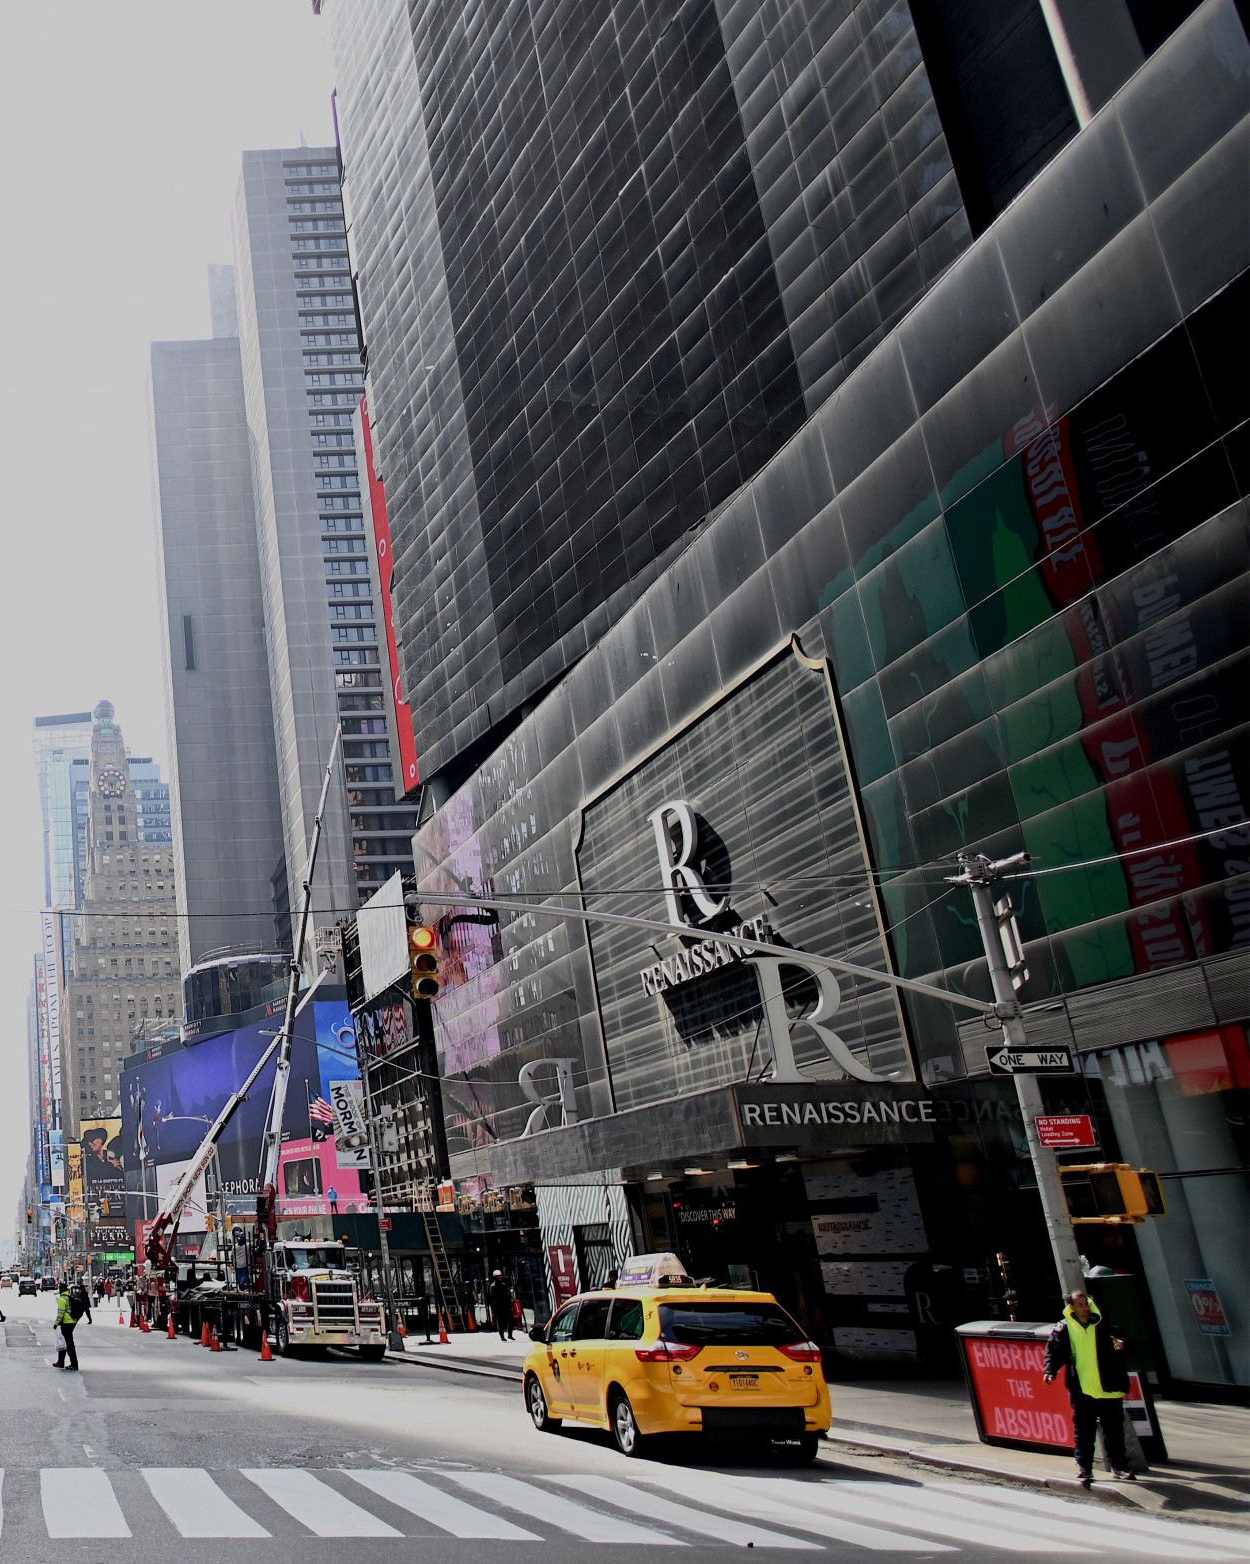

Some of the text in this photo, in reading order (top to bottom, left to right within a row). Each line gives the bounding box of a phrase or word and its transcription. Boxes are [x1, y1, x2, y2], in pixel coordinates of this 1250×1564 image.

[646, 800, 732, 936] R
[740, 955, 900, 1085] R
[999, 1053, 1067, 1066] ONE WAY
[742, 1099, 938, 1126] RENAISSANCE
[1048, 1116, 1081, 1126] STANDING
[680, 1207, 736, 1223] DISCOVER THIS WAY
[913, 1290, 943, 1325] R
[973, 1342, 1049, 1373] EMBRAC
[1006, 1378, 1035, 1399] THE
[994, 1405, 1069, 1444] ABSURD
